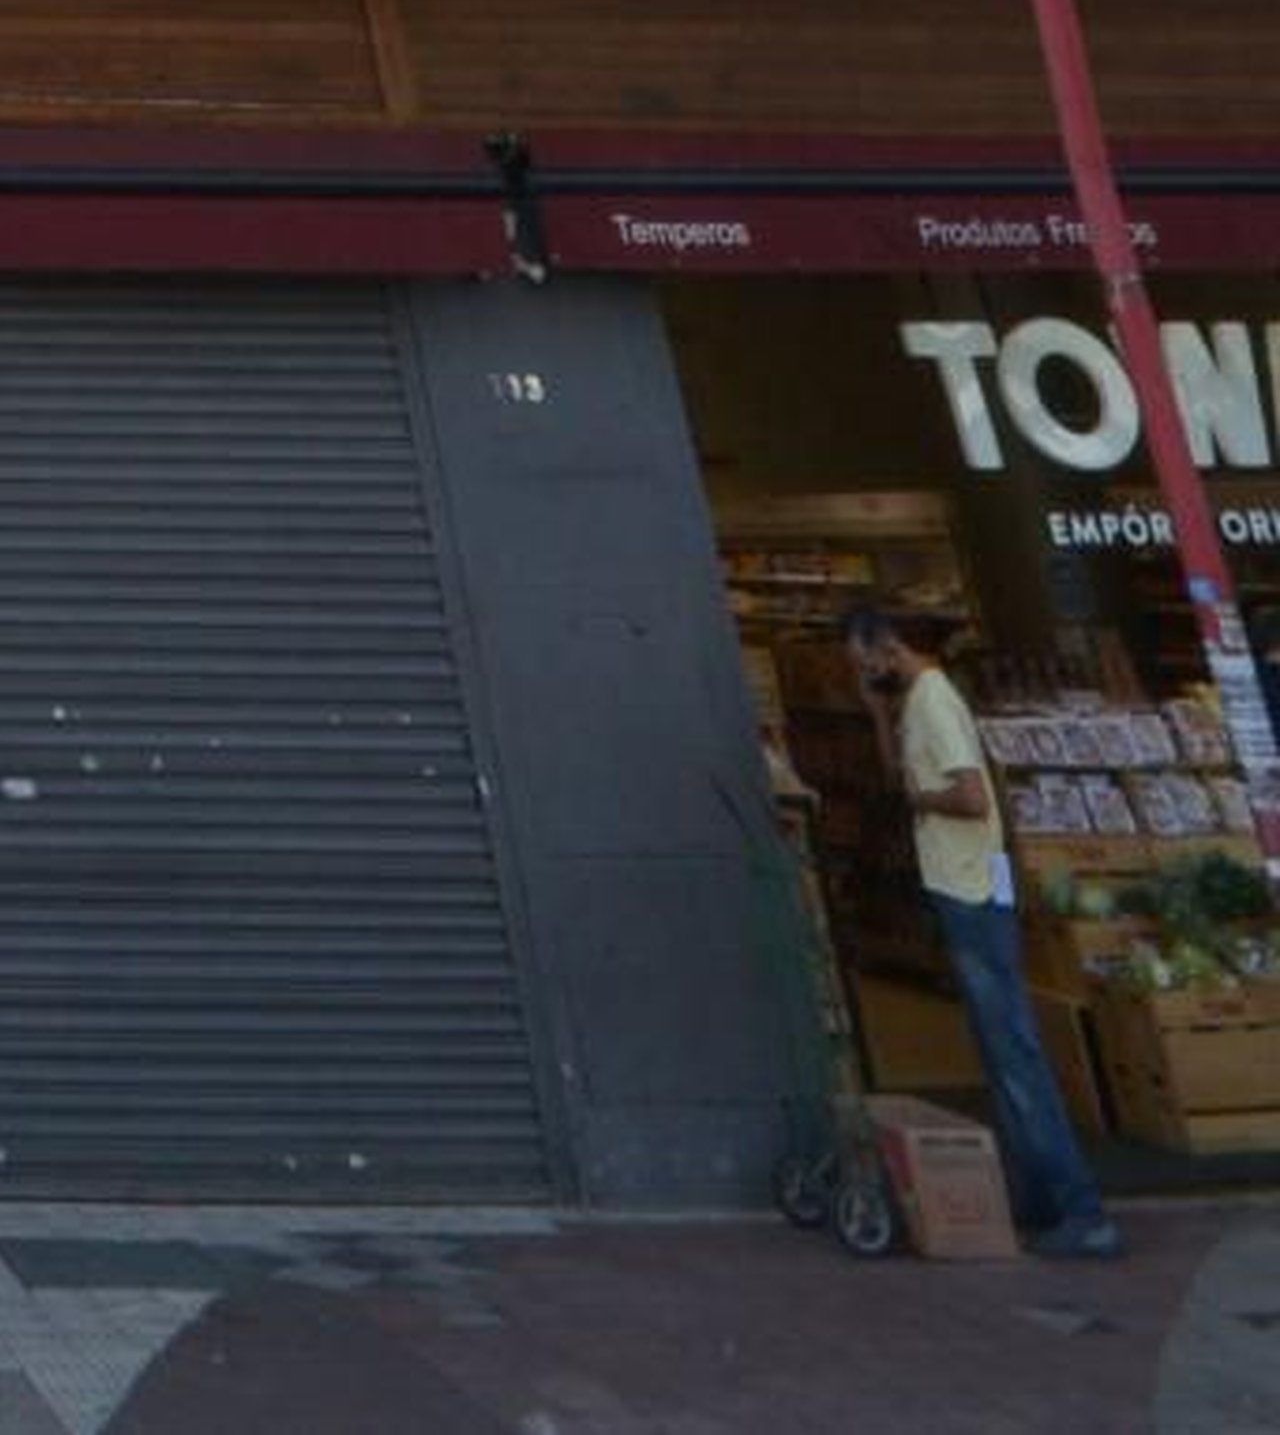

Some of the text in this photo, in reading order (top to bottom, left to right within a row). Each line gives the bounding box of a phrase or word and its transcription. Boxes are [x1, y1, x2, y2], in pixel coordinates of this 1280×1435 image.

[612, 213, 750, 247] Temperos
[918, 216, 1041, 247] Produtos
[1046, 502, 1177, 546] EMPÓR
